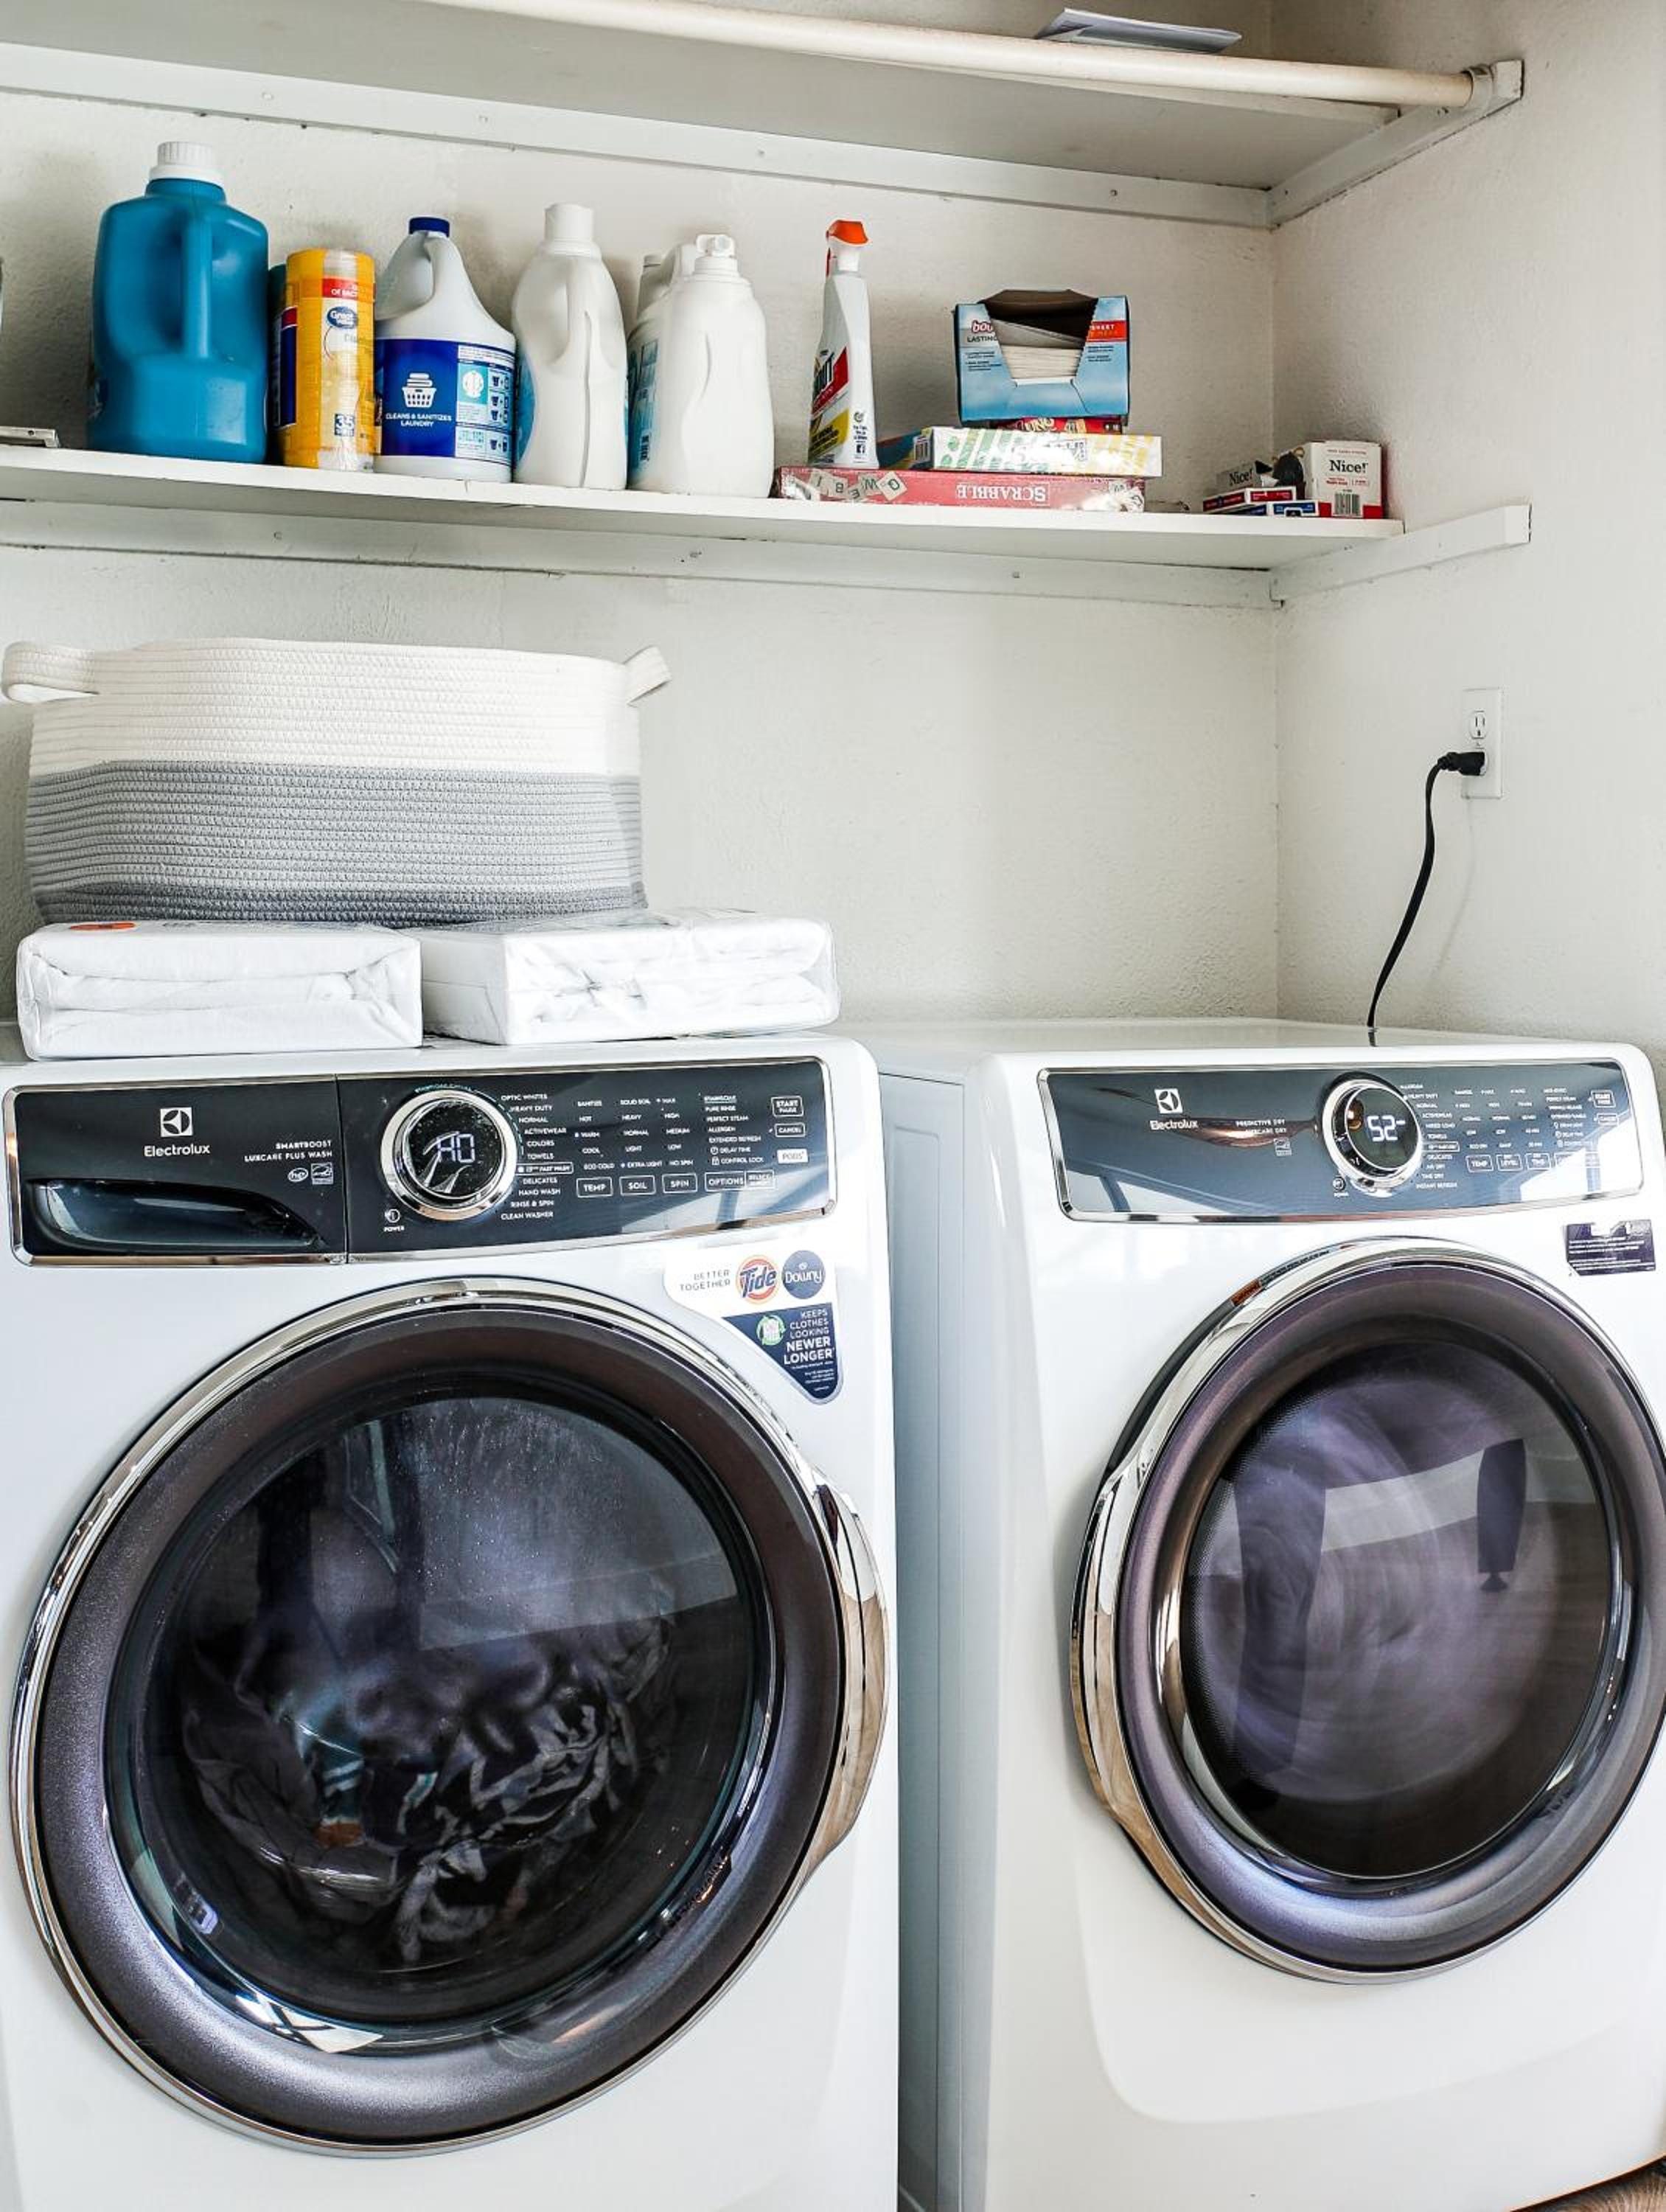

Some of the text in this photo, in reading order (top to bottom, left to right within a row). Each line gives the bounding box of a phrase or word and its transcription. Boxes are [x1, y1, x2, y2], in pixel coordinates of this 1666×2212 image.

[335, 415, 355, 429] 35
[1329, 460, 1366, 473] Nice!
[1230, 468, 1252, 486] Nice!
[956, 485, 1046, 501] SCRABBLE
[1150, 1119, 1199, 1130] Electrolux
[144, 1143, 210, 1157] Electrolux
[276, 1140, 332, 1150] SMARTBOOST
[244, 1153, 282, 1162] LUXCARE
[285, 1152, 306, 1160] PLUS
[627, 1181, 648, 1190] SOIL
[670, 1180, 689, 1189] SPIN
[708, 1178, 744, 1186] OPTIONS
[583, 1184, 607, 1192] TEMP
[694, 1270, 729, 1281] BETTER
[785, 1270, 823, 1284] Downy
[680, 1280, 731, 1291] TOGETHER
[739, 1266, 777, 1298] Tide
[801, 1309, 827, 1319] KEEPS
[790, 1318, 829, 1329] CLOTHES
[790, 1327, 829, 1339] LOOKING
[787, 1336, 831, 1352] NEWER
